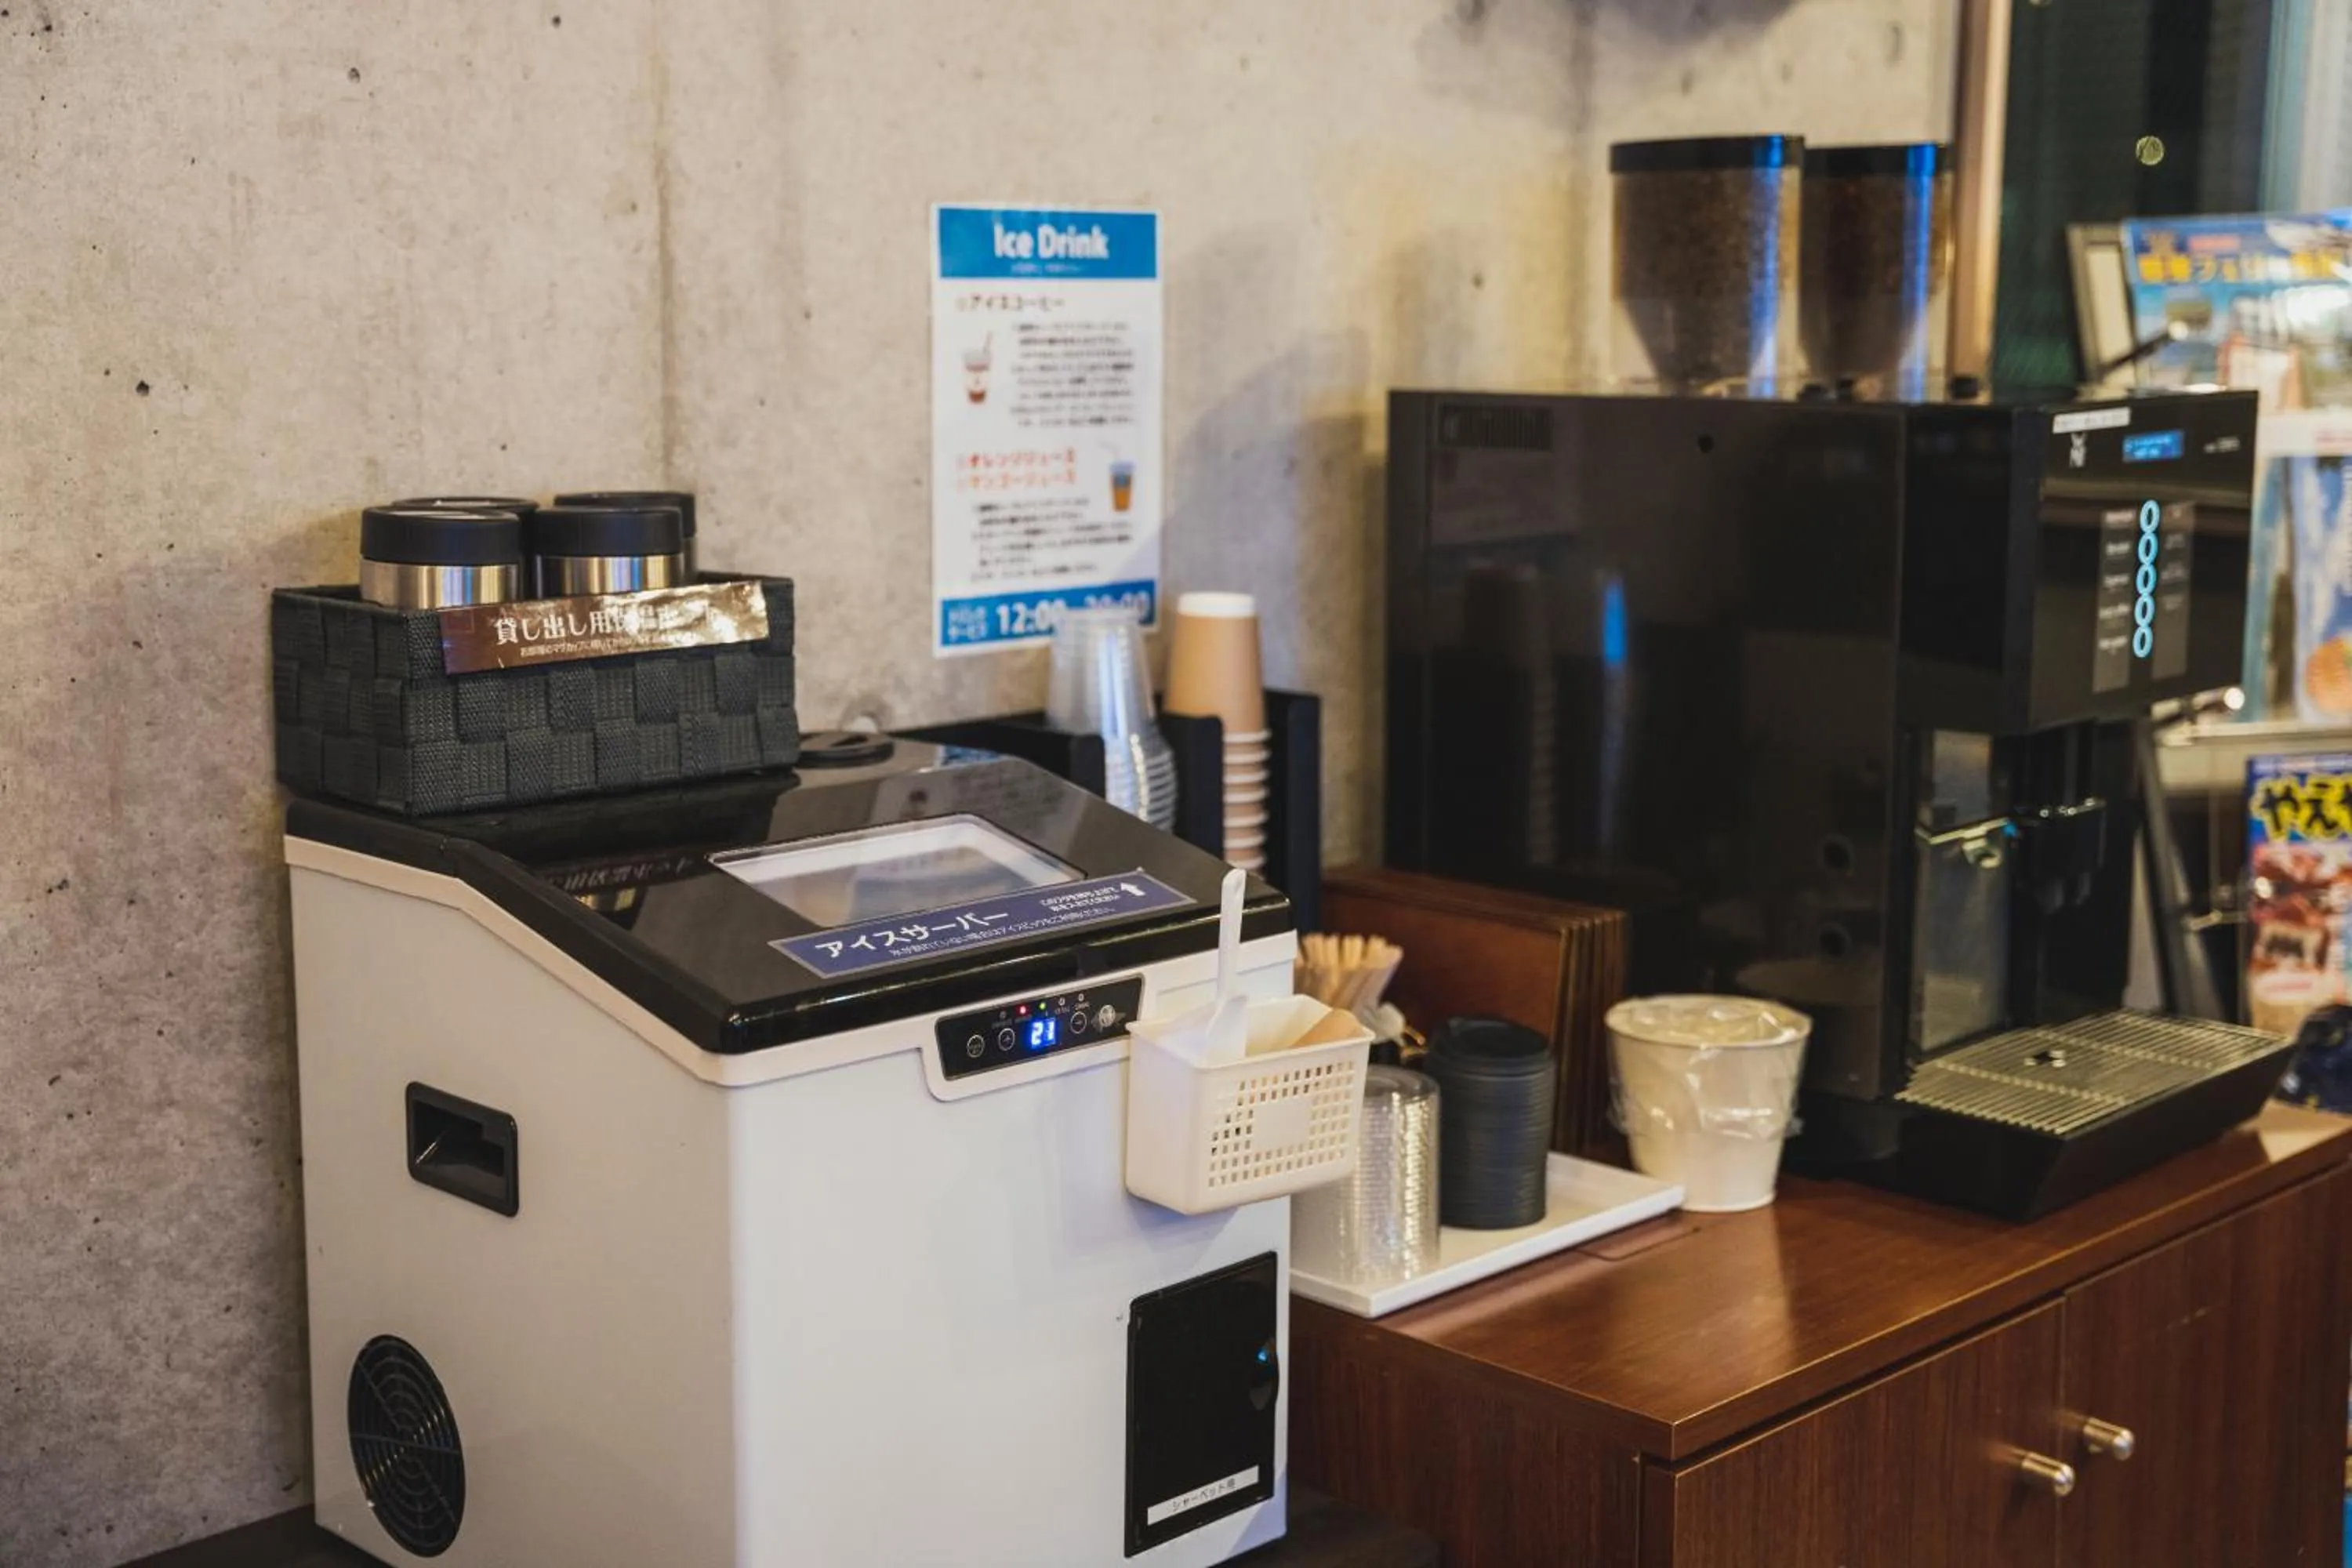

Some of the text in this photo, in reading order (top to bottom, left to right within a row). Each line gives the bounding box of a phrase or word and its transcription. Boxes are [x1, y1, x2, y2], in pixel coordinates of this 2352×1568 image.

[993, 223, 1110, 260] Ice Drink
[814, 912, 1009, 958] アイスサーバー
[1031, 1021, 1055, 1046] 21
